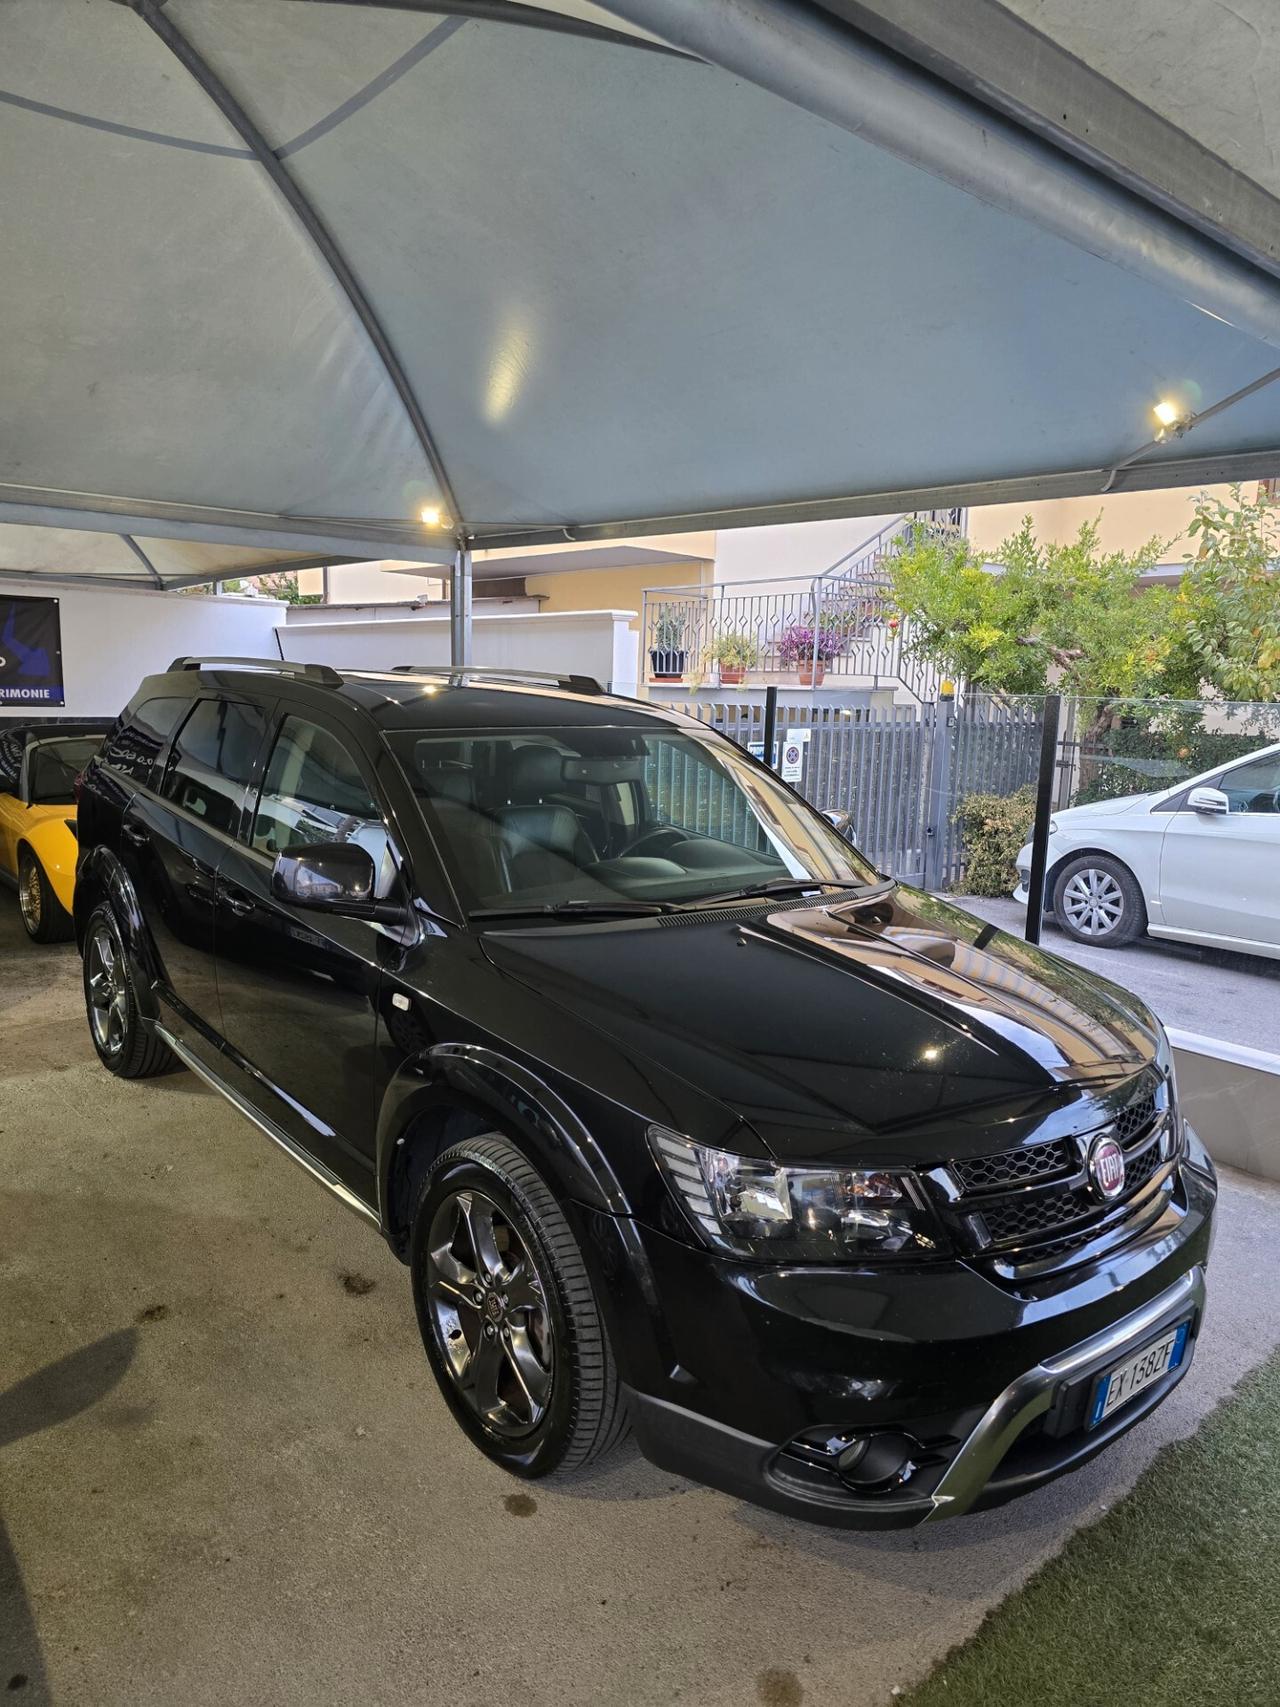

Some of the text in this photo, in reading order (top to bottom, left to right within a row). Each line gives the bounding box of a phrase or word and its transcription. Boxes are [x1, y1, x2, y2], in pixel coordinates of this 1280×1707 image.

[1099, 1153, 1119, 1187] FIAT
[1106, 1339, 1175, 1407] EX 138ZF
